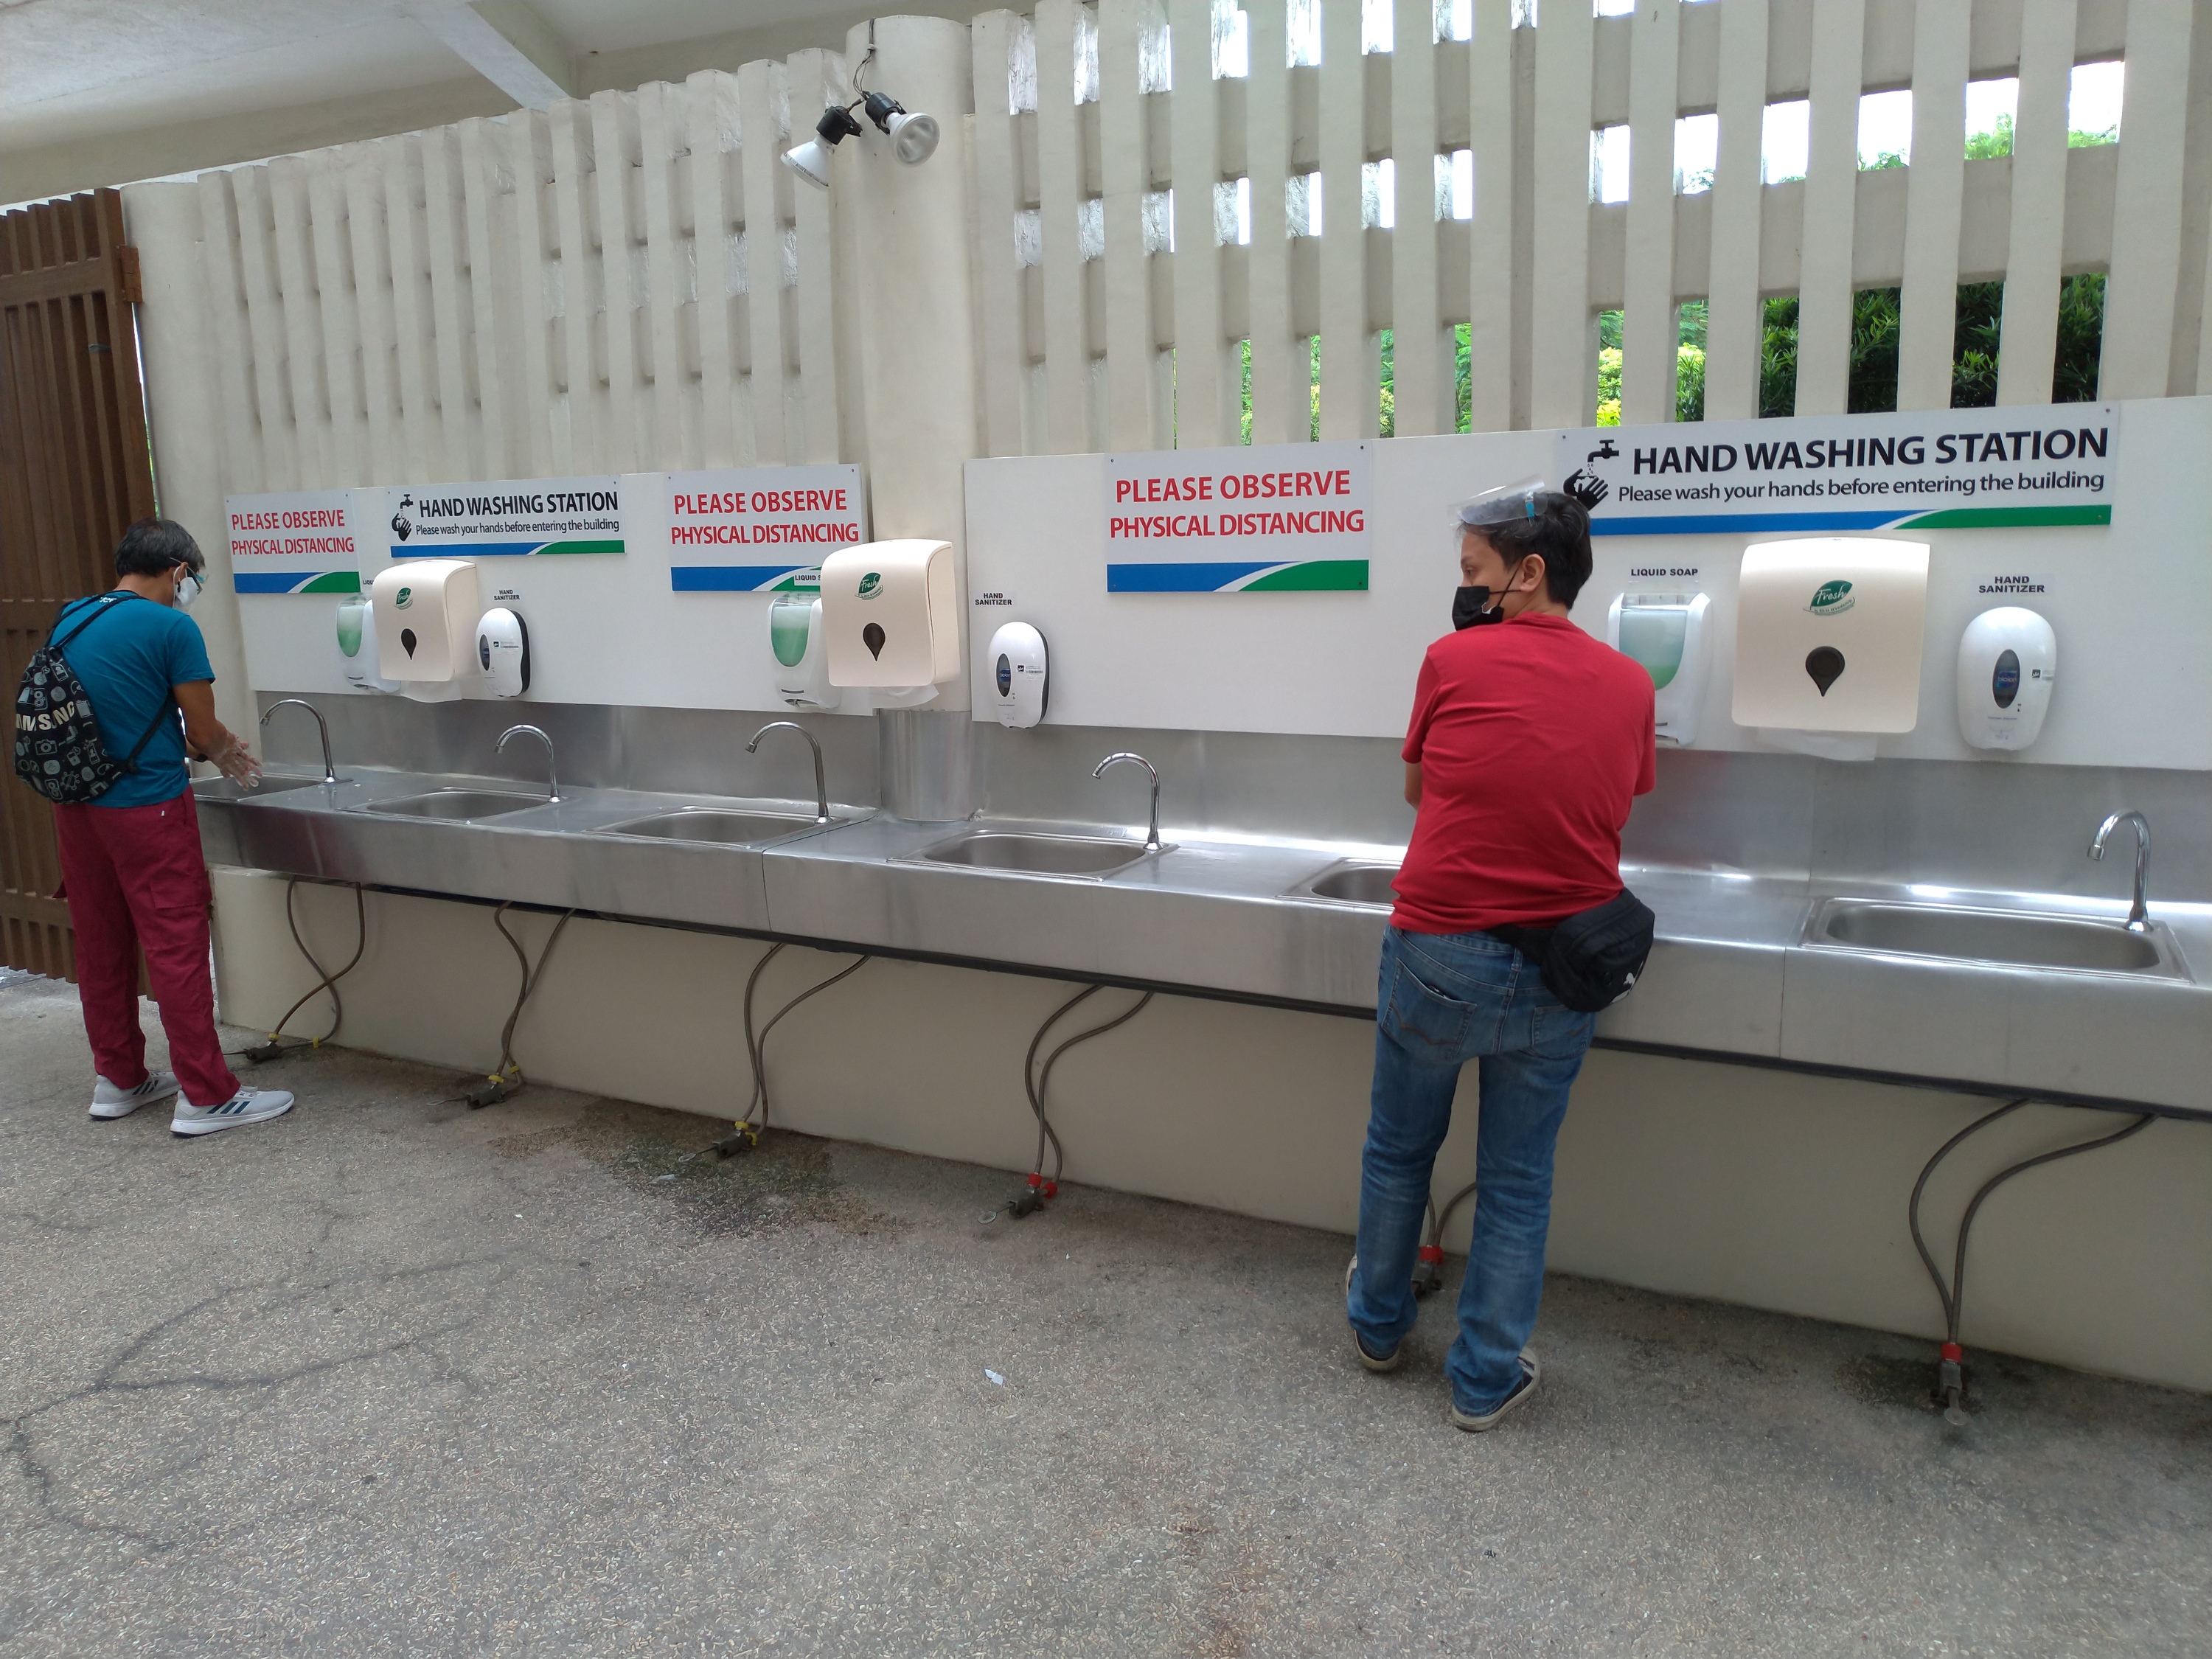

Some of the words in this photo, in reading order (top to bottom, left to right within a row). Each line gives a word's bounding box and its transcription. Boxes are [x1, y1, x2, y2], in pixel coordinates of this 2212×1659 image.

[1634, 445, 1737, 474] HAND
[1745, 437, 1924, 470] WASHING
[1935, 428, 2108, 464] STATION
[1117, 477, 1212, 503] PLEASE
[1220, 470, 1350, 499] OBSERVE
[1619, 486, 1672, 501] Please
[1675, 483, 1719, 499] wash
[1724, 486, 1765, 502] your
[1769, 480, 1823, 497] hands
[1829, 478, 1889, 495] before
[1893, 476, 1975, 495] entering
[1980, 473, 2014, 490] the
[2018, 471, 2104, 492] building
[420, 498, 464, 517] HAND
[466, 495, 543, 515] WASHING
[547, 492, 618, 512] STATION
[675, 493, 746, 514] PLEASE
[752, 490, 846, 512] OBSERVE
[232, 512, 279, 530] PLEASE
[282, 510, 344, 528] OBSERVE
[416, 525, 439, 535] Please
[440, 524, 459, 534] wash
[461, 526, 479, 536] your
[479, 522, 504, 533] hands
[505, 521, 531, 532] before
[532, 521, 566, 533] entering
[568, 520, 582, 530] the
[584, 518, 619, 532] building
[1111, 515, 1215, 538] PHYSICAL
[1220, 510, 1363, 535] DISTANCING
[672, 526, 750, 544] PHYSICAL
[753, 524, 858, 543] DISTANCING
[232, 540, 284, 554] PHYSICAL
[285, 538, 354, 554] DISTANCING
[860, 575, 878, 591] Fresh
[1631, 568, 1666, 577] LIQUID
[1815, 583, 1848, 605] Fresh
[16, 701, 74, 731] AMSUNG
